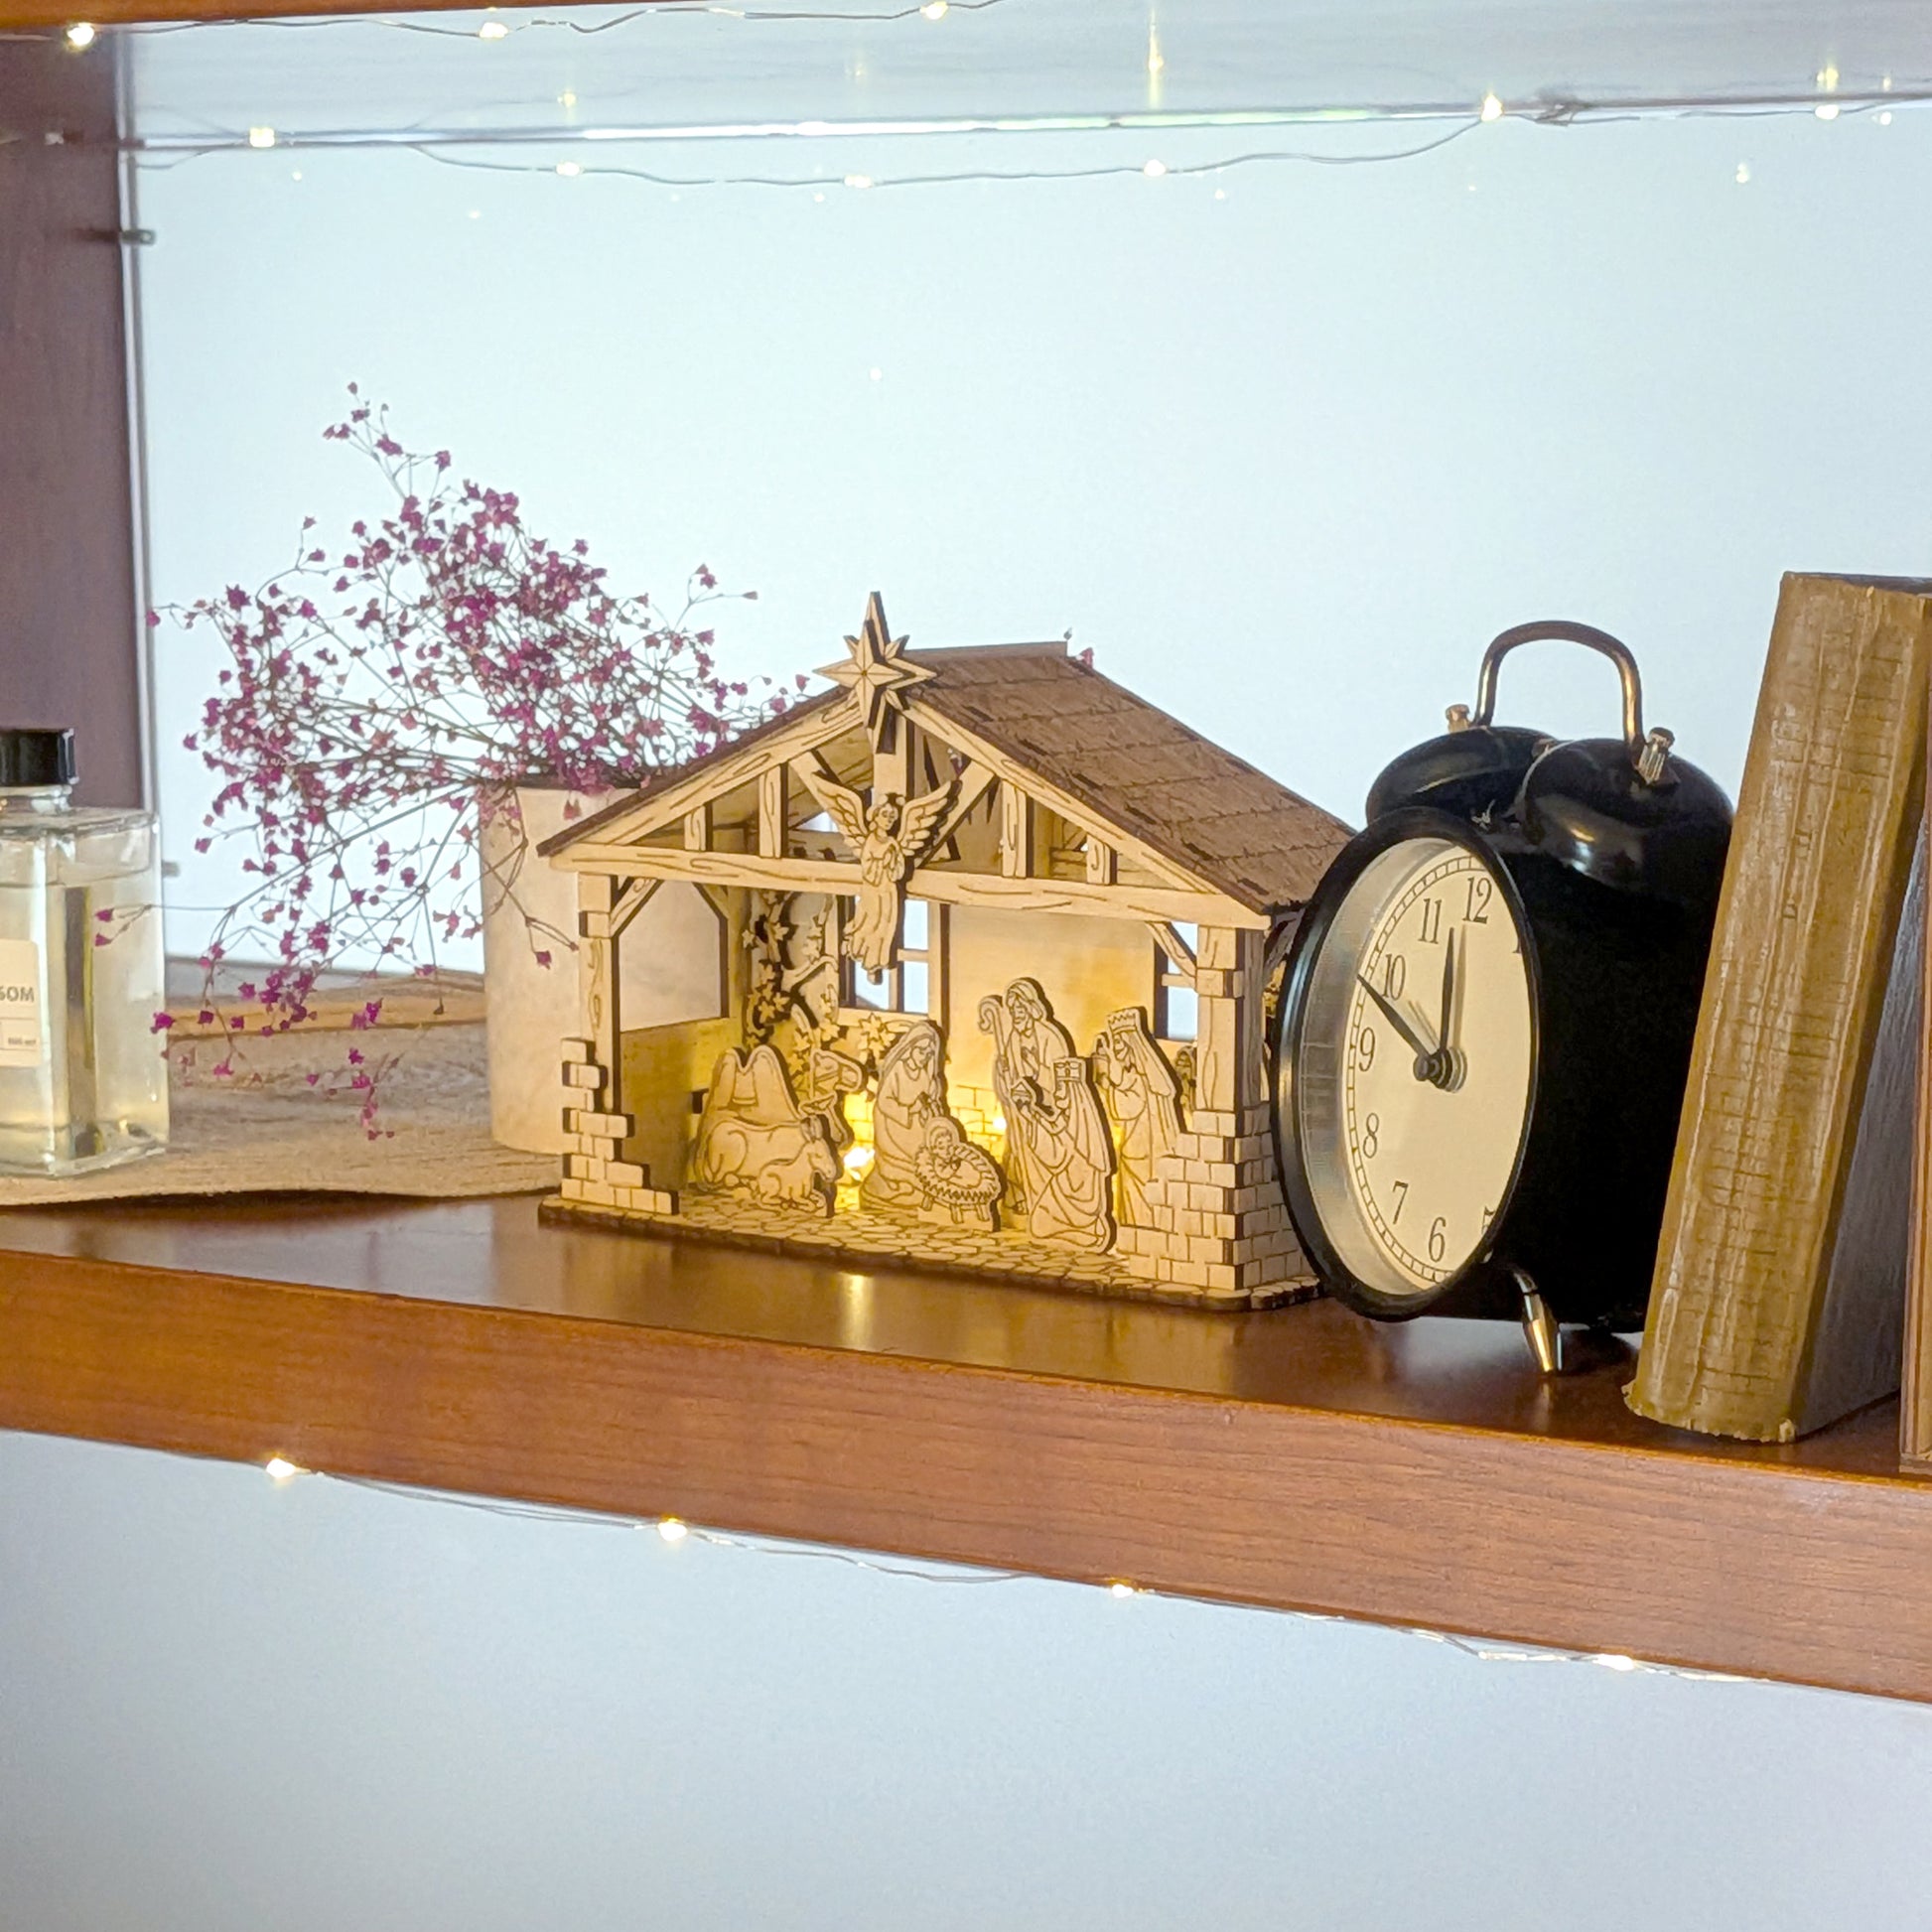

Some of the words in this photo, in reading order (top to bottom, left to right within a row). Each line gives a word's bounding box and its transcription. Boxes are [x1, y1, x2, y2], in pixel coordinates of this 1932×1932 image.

[1418, 897, 1443, 944] 11
[1462, 876, 1492, 924] 12
[1381, 953, 1406, 1001] 10
[1359, 1027, 1375, 1072] 9
[1363, 1112, 1380, 1159] 8
[1393, 1180, 1409, 1225] 7
[1428, 1216, 1447, 1263] 6
